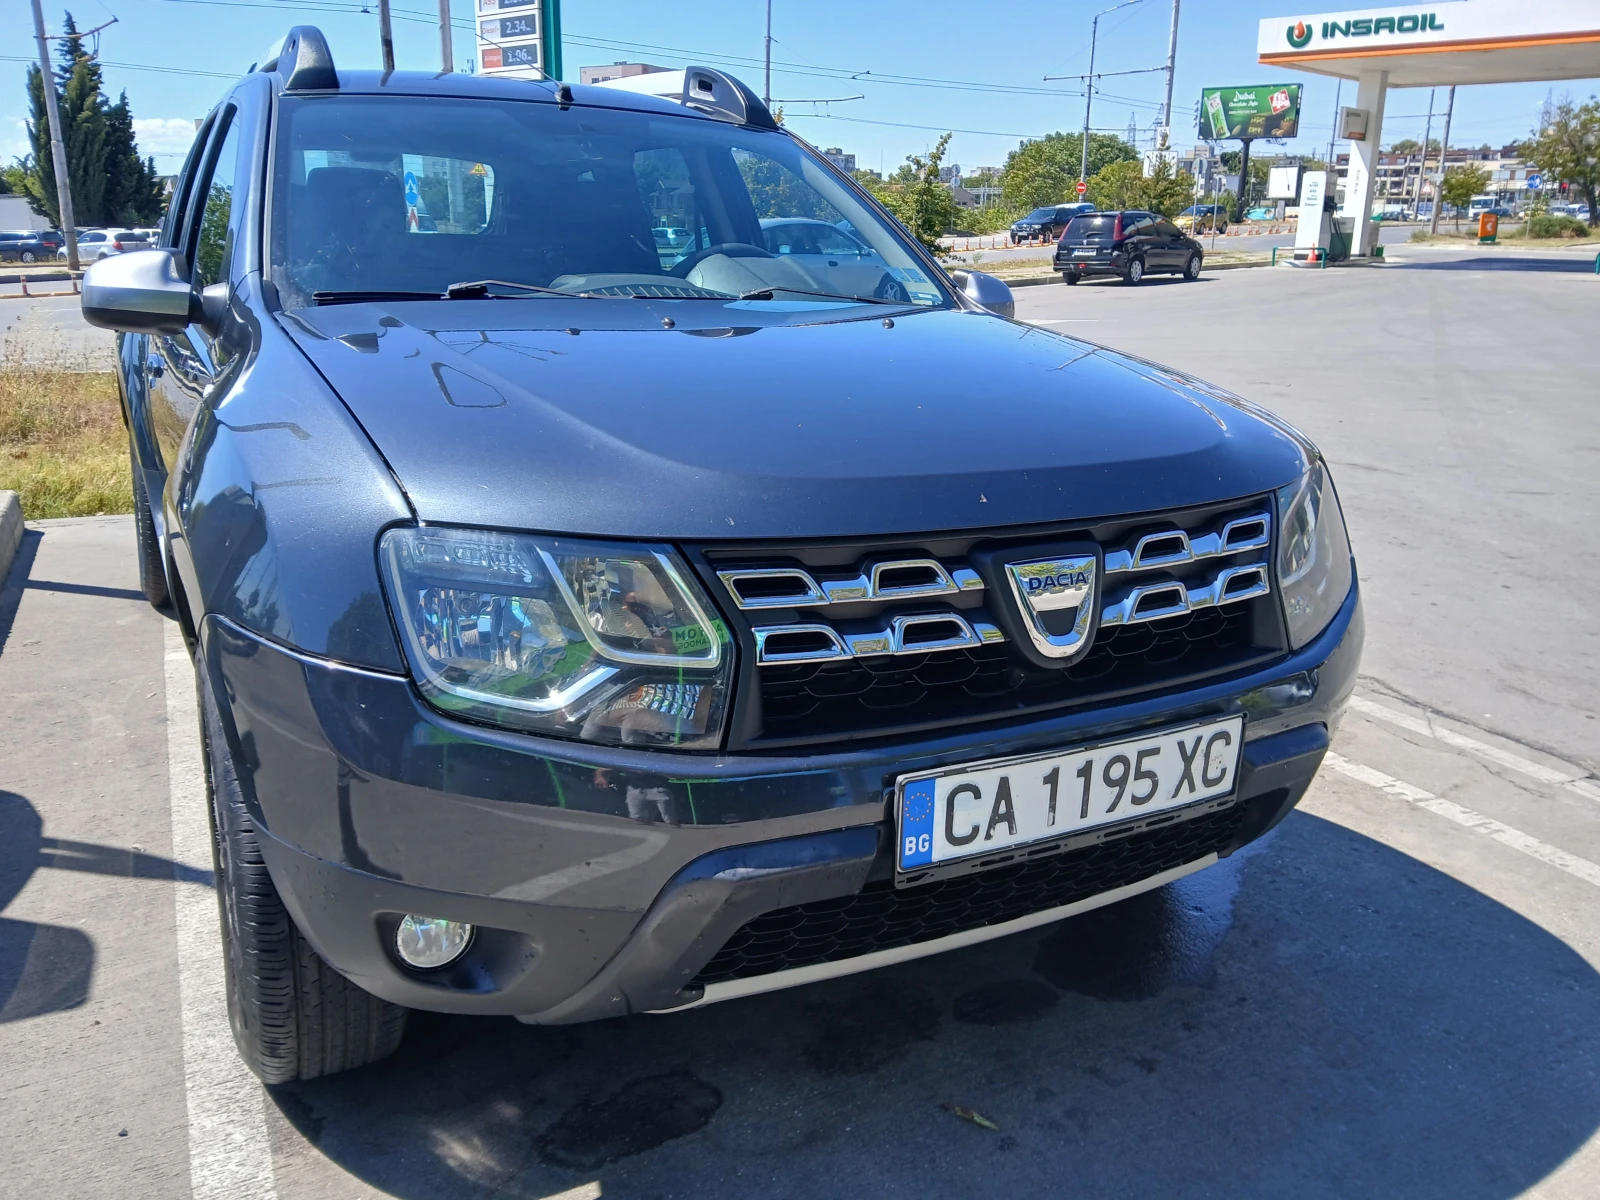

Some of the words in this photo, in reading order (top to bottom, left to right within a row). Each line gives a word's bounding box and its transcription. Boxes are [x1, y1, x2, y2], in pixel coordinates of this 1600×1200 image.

[506, 20, 526, 33] 2.34
[1321, 13, 1445, 39] INSAOIL
[1234, 91, 1255, 101] Dubai
[1028, 572, 1088, 590] DACIA
[944, 776, 1018, 847] CA
[1042, 747, 1161, 828] 1195
[1171, 730, 1232, 799] XC
[905, 833, 930, 856] BG
